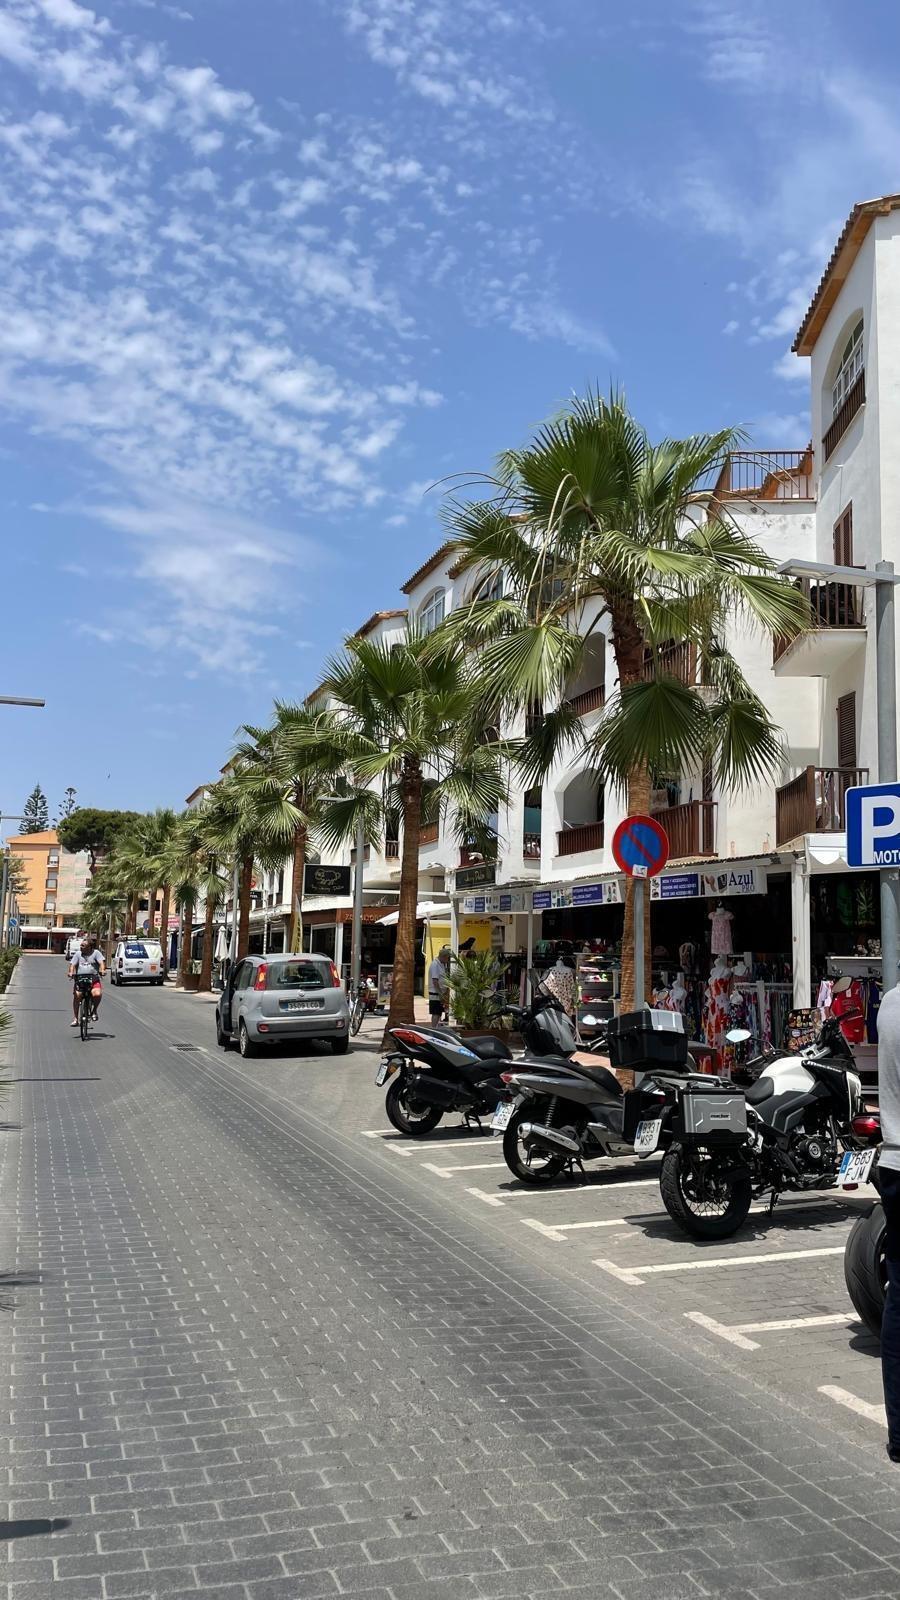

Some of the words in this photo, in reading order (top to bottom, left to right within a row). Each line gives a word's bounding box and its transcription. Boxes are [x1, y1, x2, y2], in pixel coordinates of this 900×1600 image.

[861, 795, 900, 864] P
[873, 850, 900, 863] MOT
[728, 870, 753, 886] Azul
